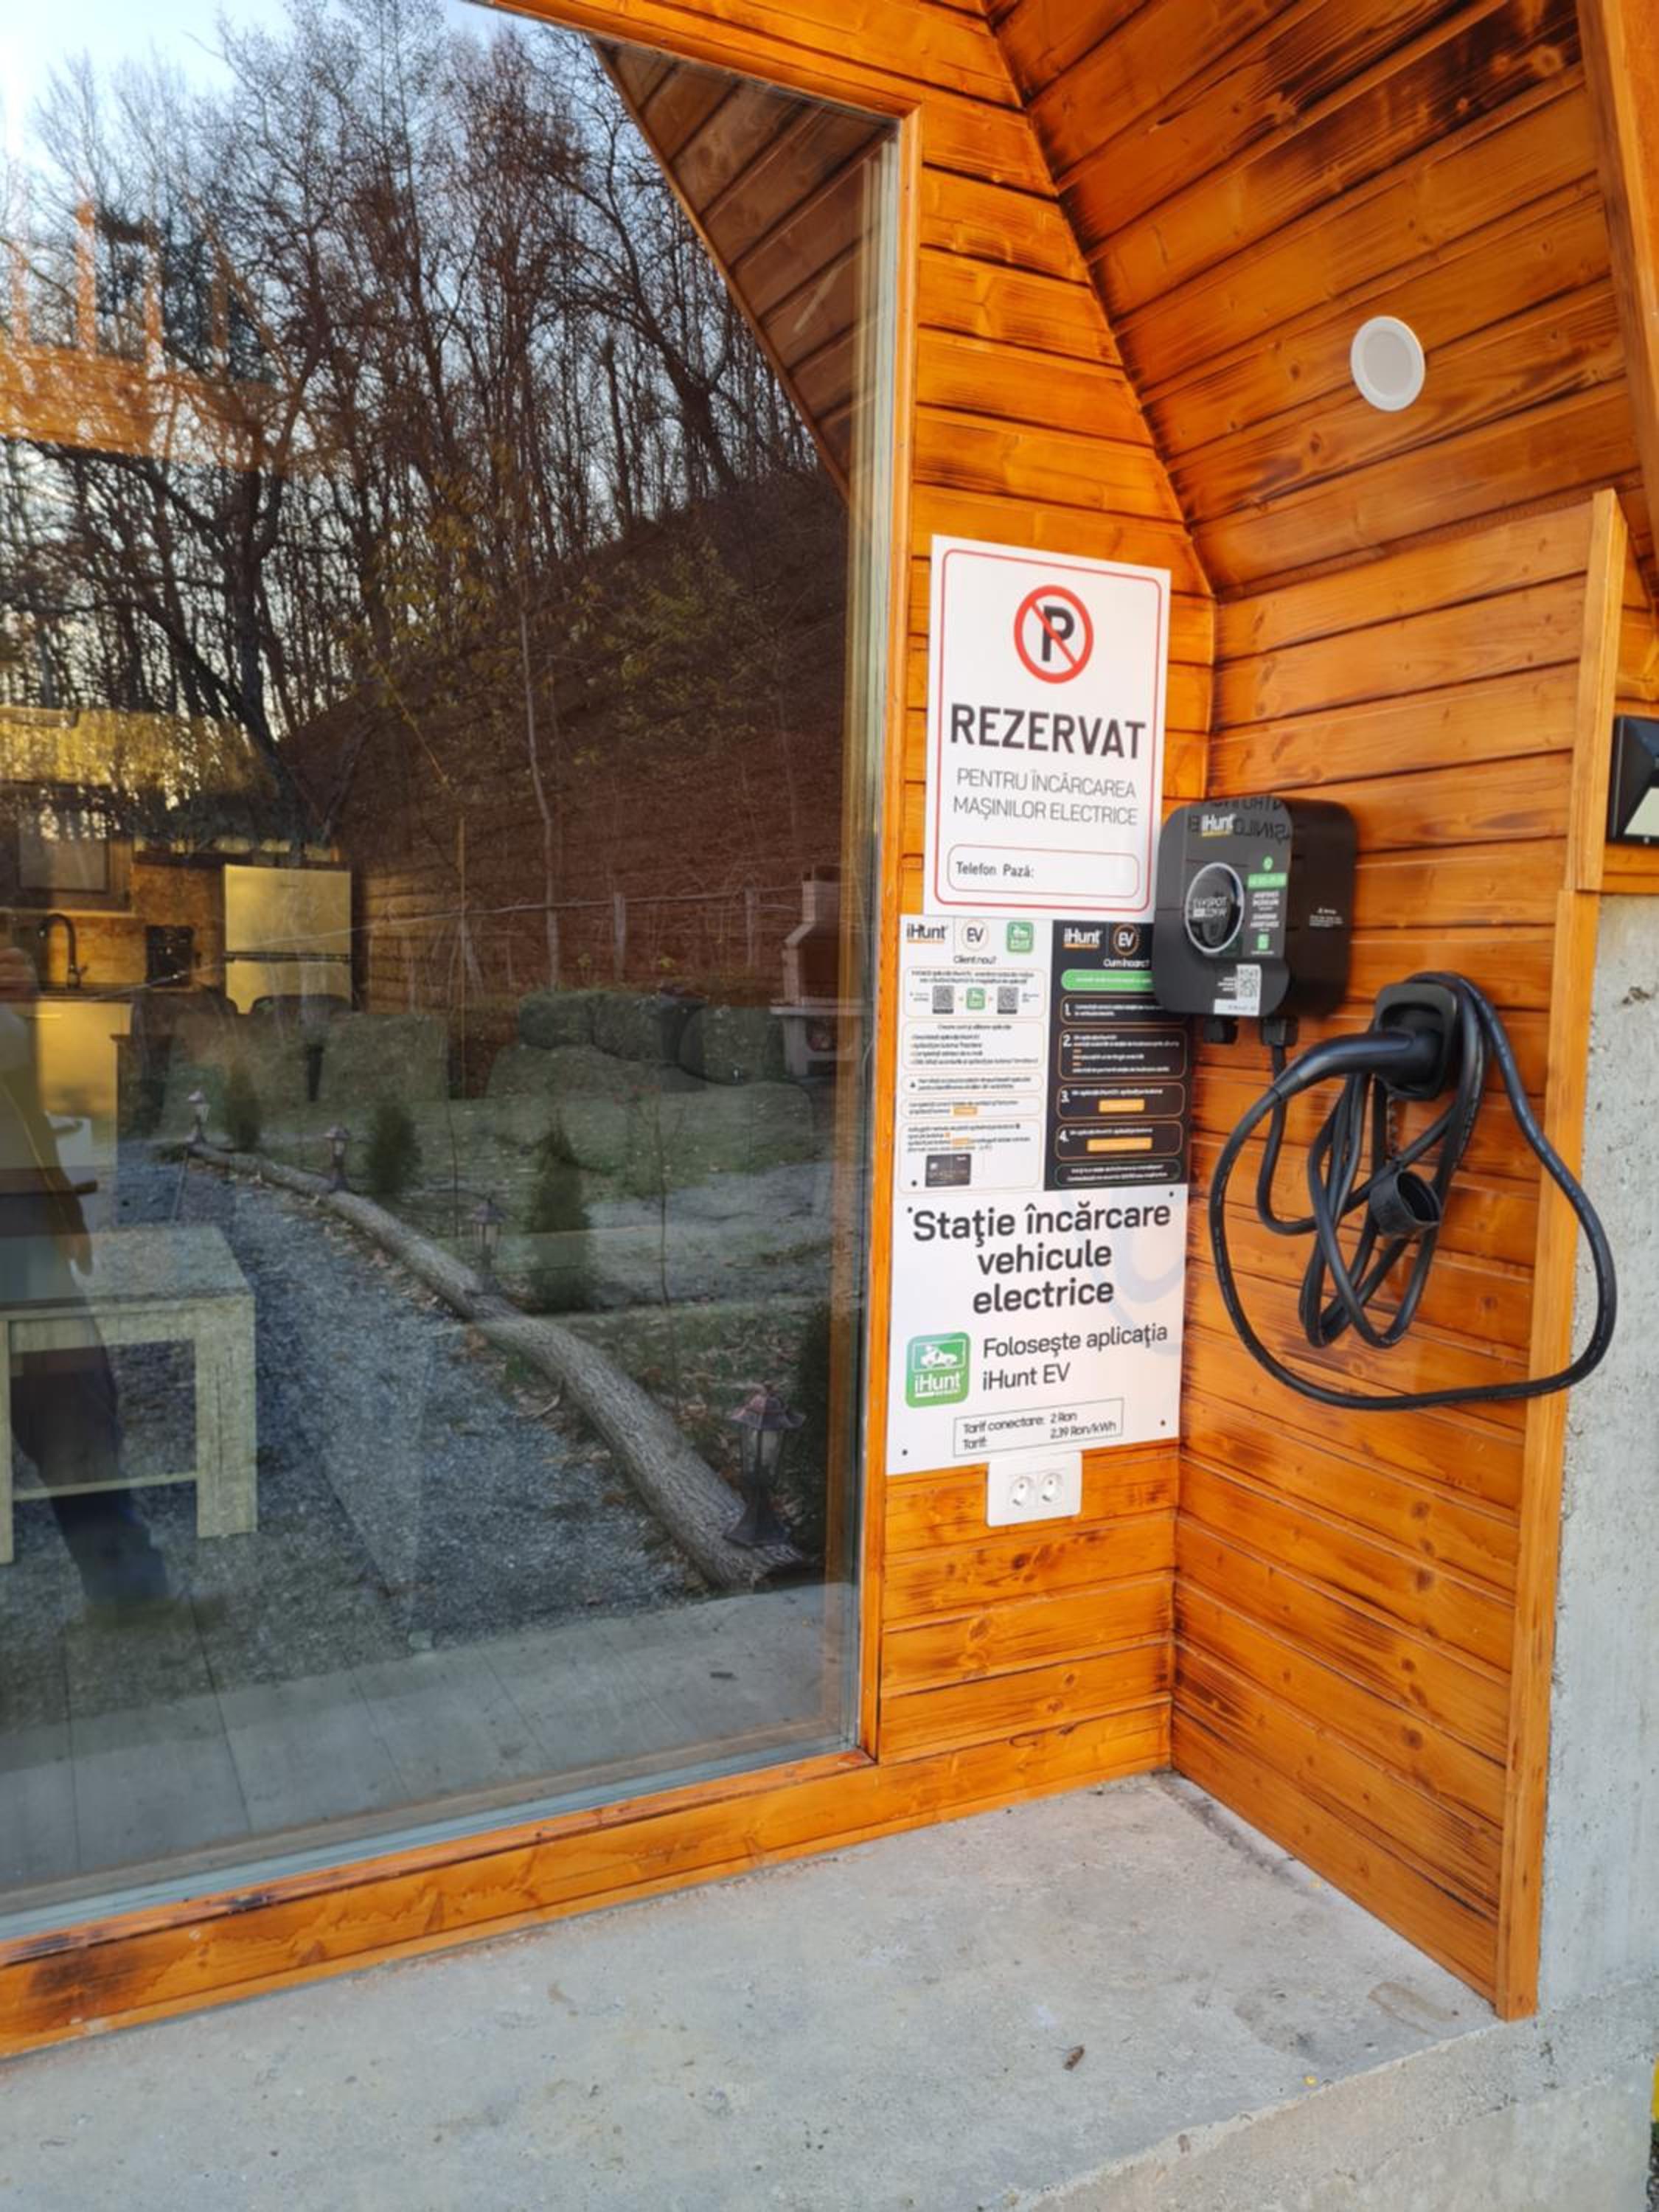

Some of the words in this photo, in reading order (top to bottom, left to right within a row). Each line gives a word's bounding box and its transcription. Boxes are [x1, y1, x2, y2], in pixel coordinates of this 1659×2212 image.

[1041, 605, 1075, 663] P
[950, 703, 1146, 759] REZERVAT
[957, 768, 1029, 791] PENTRU
[1032, 769, 1137, 799] ÎNCĂRCAREA
[1049, 802, 1139, 826] ELECTRICE
[956, 860, 997, 876] Telefon
[906, 922, 946, 939] iHunt
[967, 927, 984, 942] EV
[1063, 927, 1101, 945] iHunt
[1118, 931, 1134, 947] EV
[913, 1206, 1015, 1248] Staţie
[1025, 1200, 1171, 1235] încărcare
[977, 1239, 1112, 1276] vehicule
[973, 1277, 1114, 1315] electrice
[983, 1333, 1082, 1357] Foloseşte
[1086, 1322, 1169, 1352] aplicaţia
[914, 1373, 961, 1394] iHunt
[982, 1368, 1037, 1391] iHunt
[1043, 1362, 1071, 1384] EV
[963, 1422, 987, 1434] Tarif
[1050, 1413, 1057, 1425] 2
[1058, 1411, 1077, 1422] Ron
